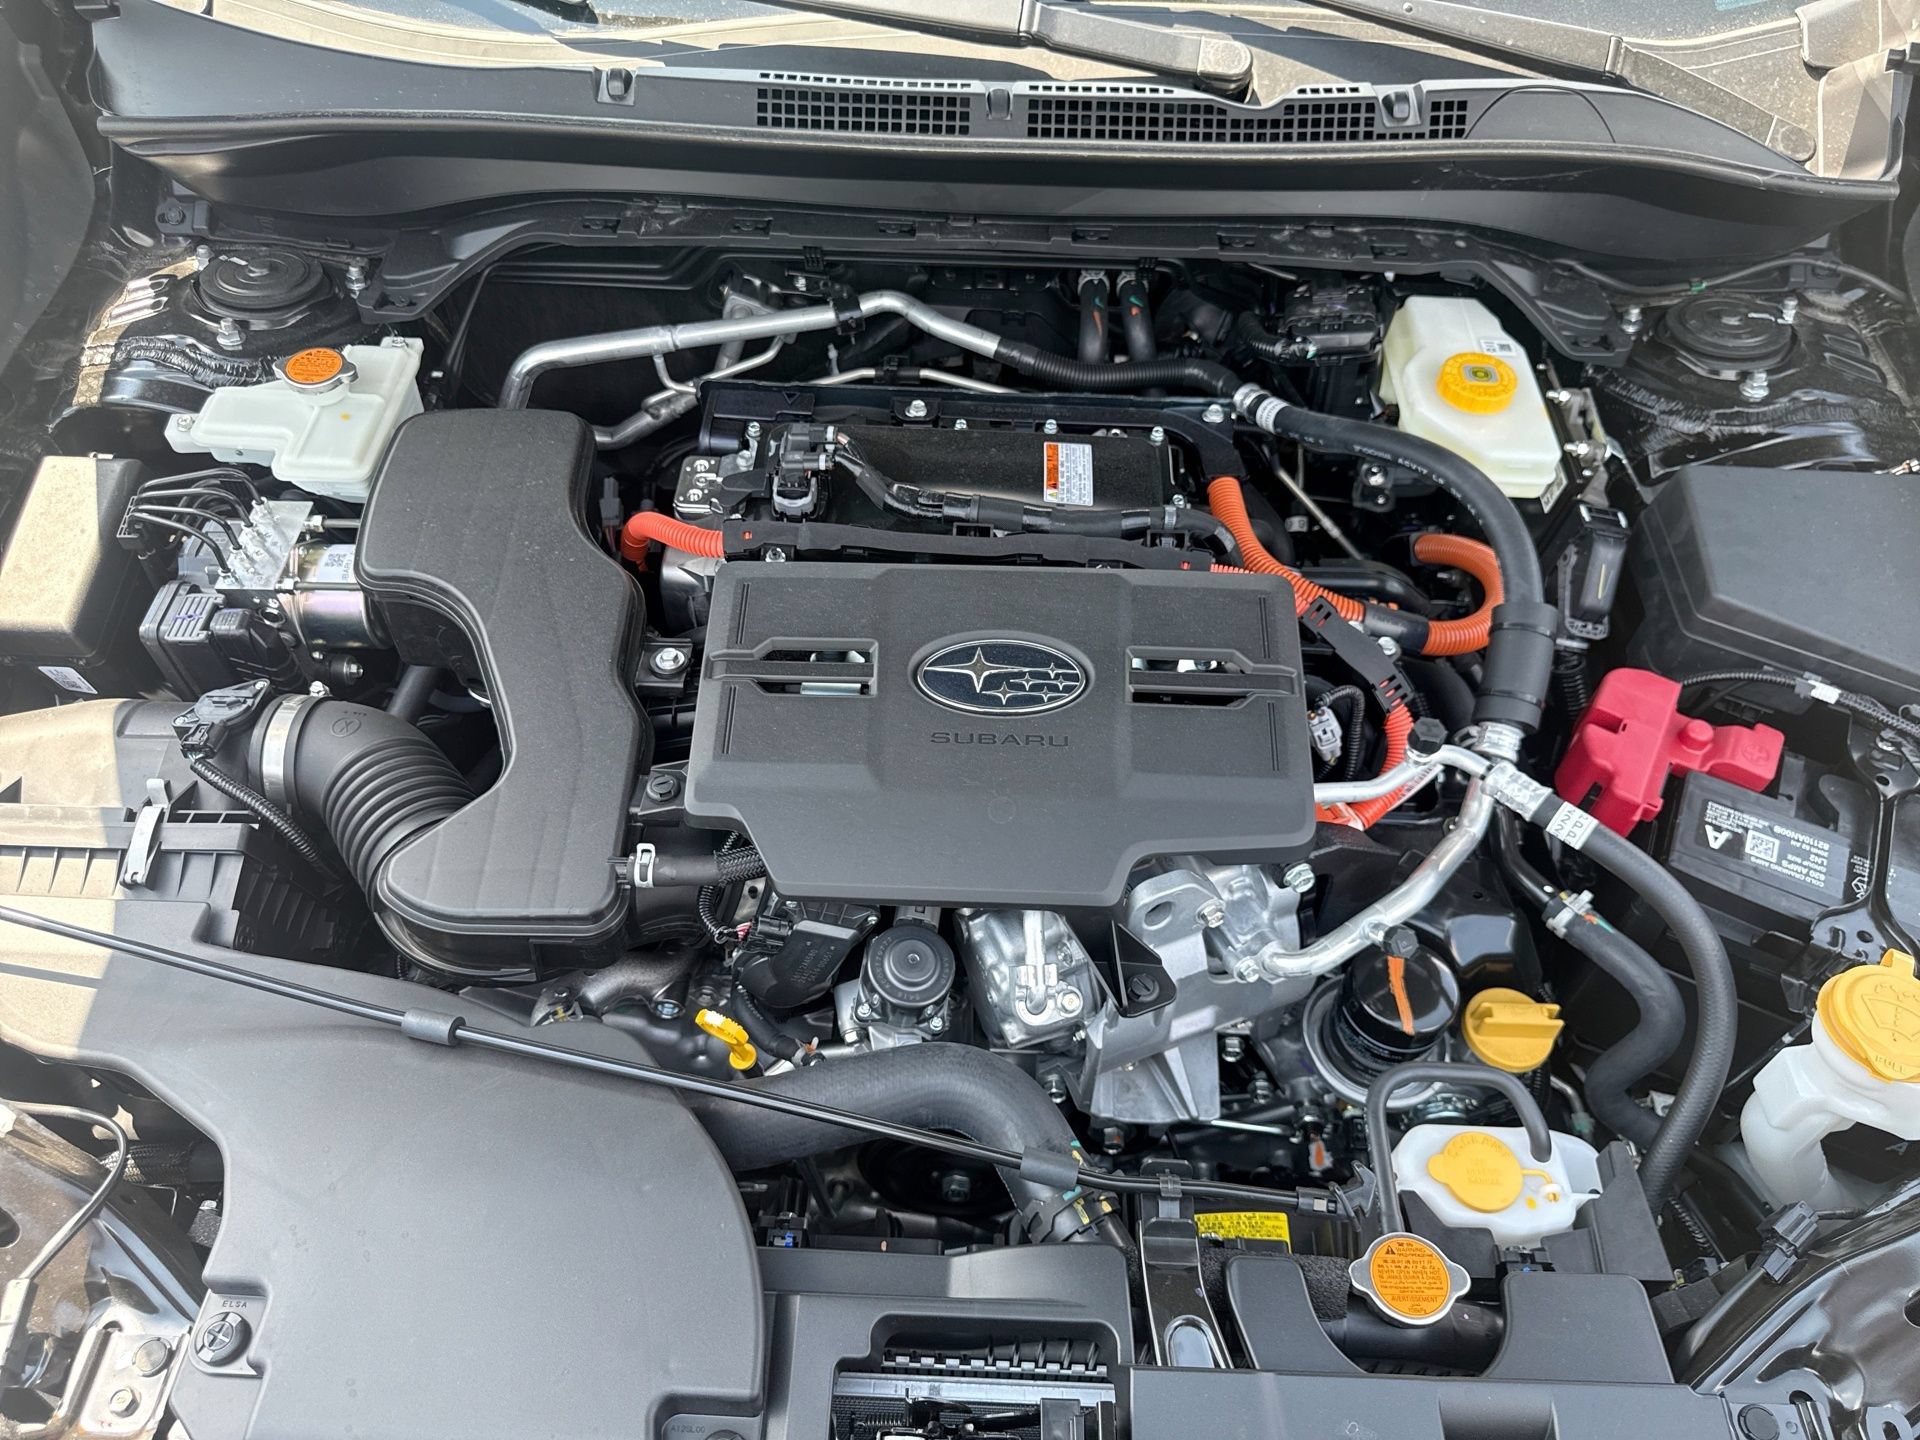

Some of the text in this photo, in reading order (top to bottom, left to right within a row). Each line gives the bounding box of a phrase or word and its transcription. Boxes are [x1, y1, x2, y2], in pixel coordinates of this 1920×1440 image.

[931, 732, 1069, 747] SUBARU
[1750, 856, 1770, 867] AMPS
[1809, 854, 1827, 866] LN2
[1782, 860, 1808, 874] AMPS
[1802, 861, 1826, 872] GROUP
[1805, 876, 1824, 887] COLD
[222, 1300, 248, 1309] ELSA
